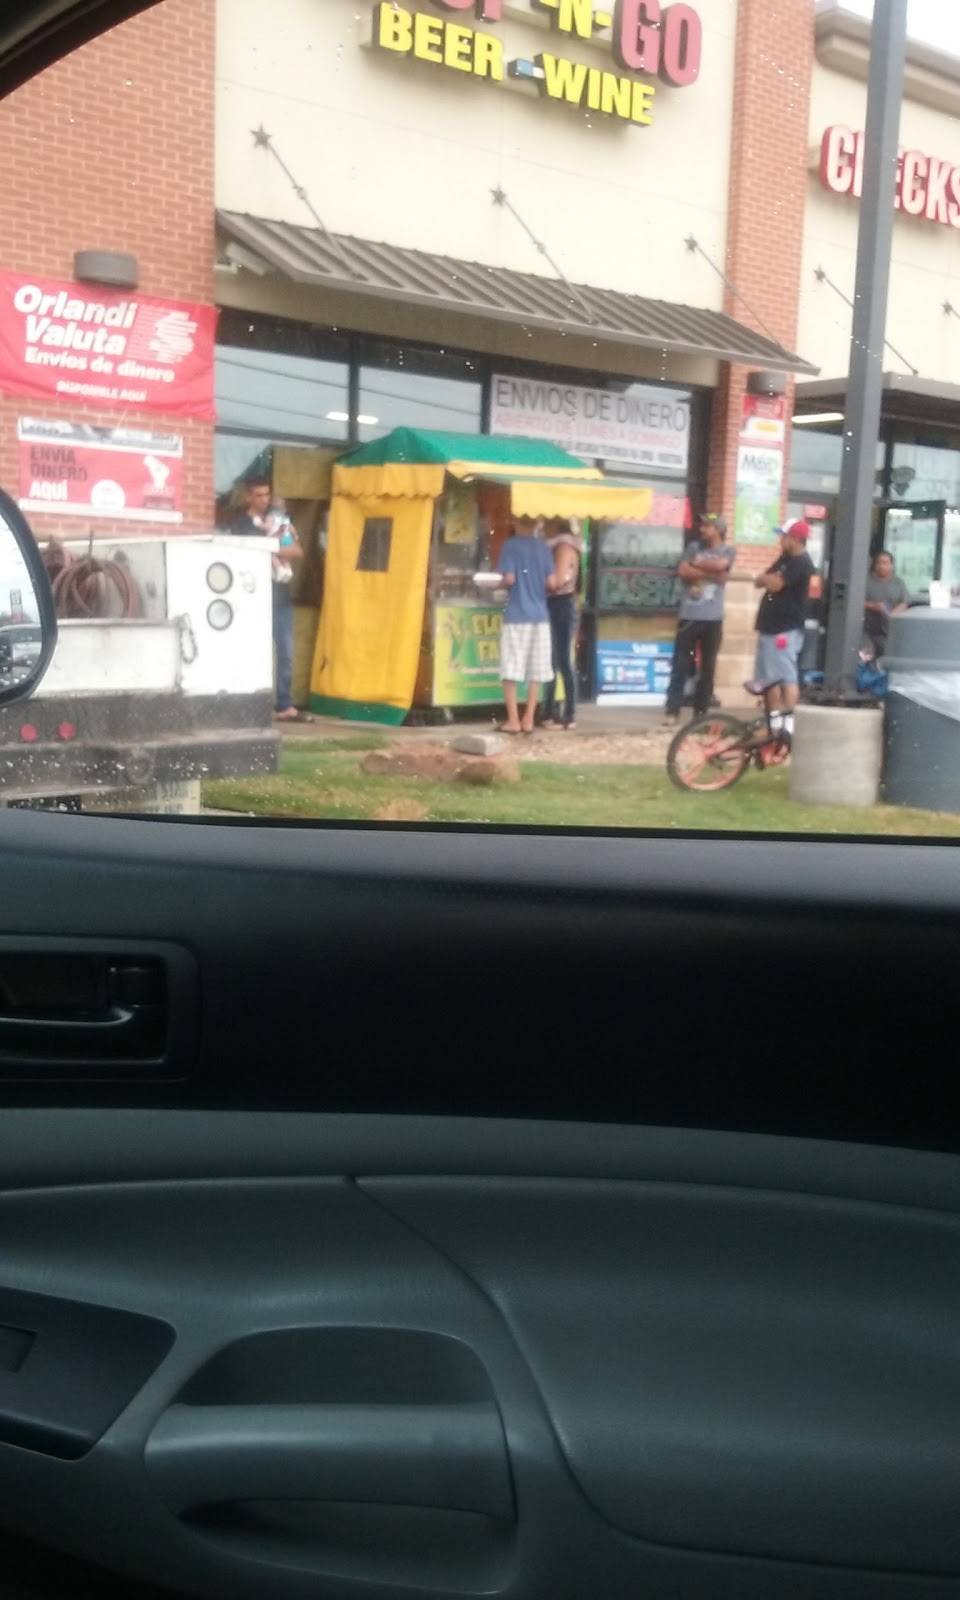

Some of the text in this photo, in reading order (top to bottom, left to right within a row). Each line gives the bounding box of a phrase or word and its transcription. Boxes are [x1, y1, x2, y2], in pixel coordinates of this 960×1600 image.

[379, 1, 656, 126] BEER WINE
[619, 0, 702, 86] GO
[14, 285, 138, 328] Orlandi
[25, 315, 126, 356] Valuta
[91, 356, 114, 374] de
[118, 358, 176, 383] dinero
[496, 379, 577, 417] ENVIOS
[582, 391, 611, 421] DE
[616, 396, 686, 433] DINERO
[29, 462, 88, 482] DINERO
